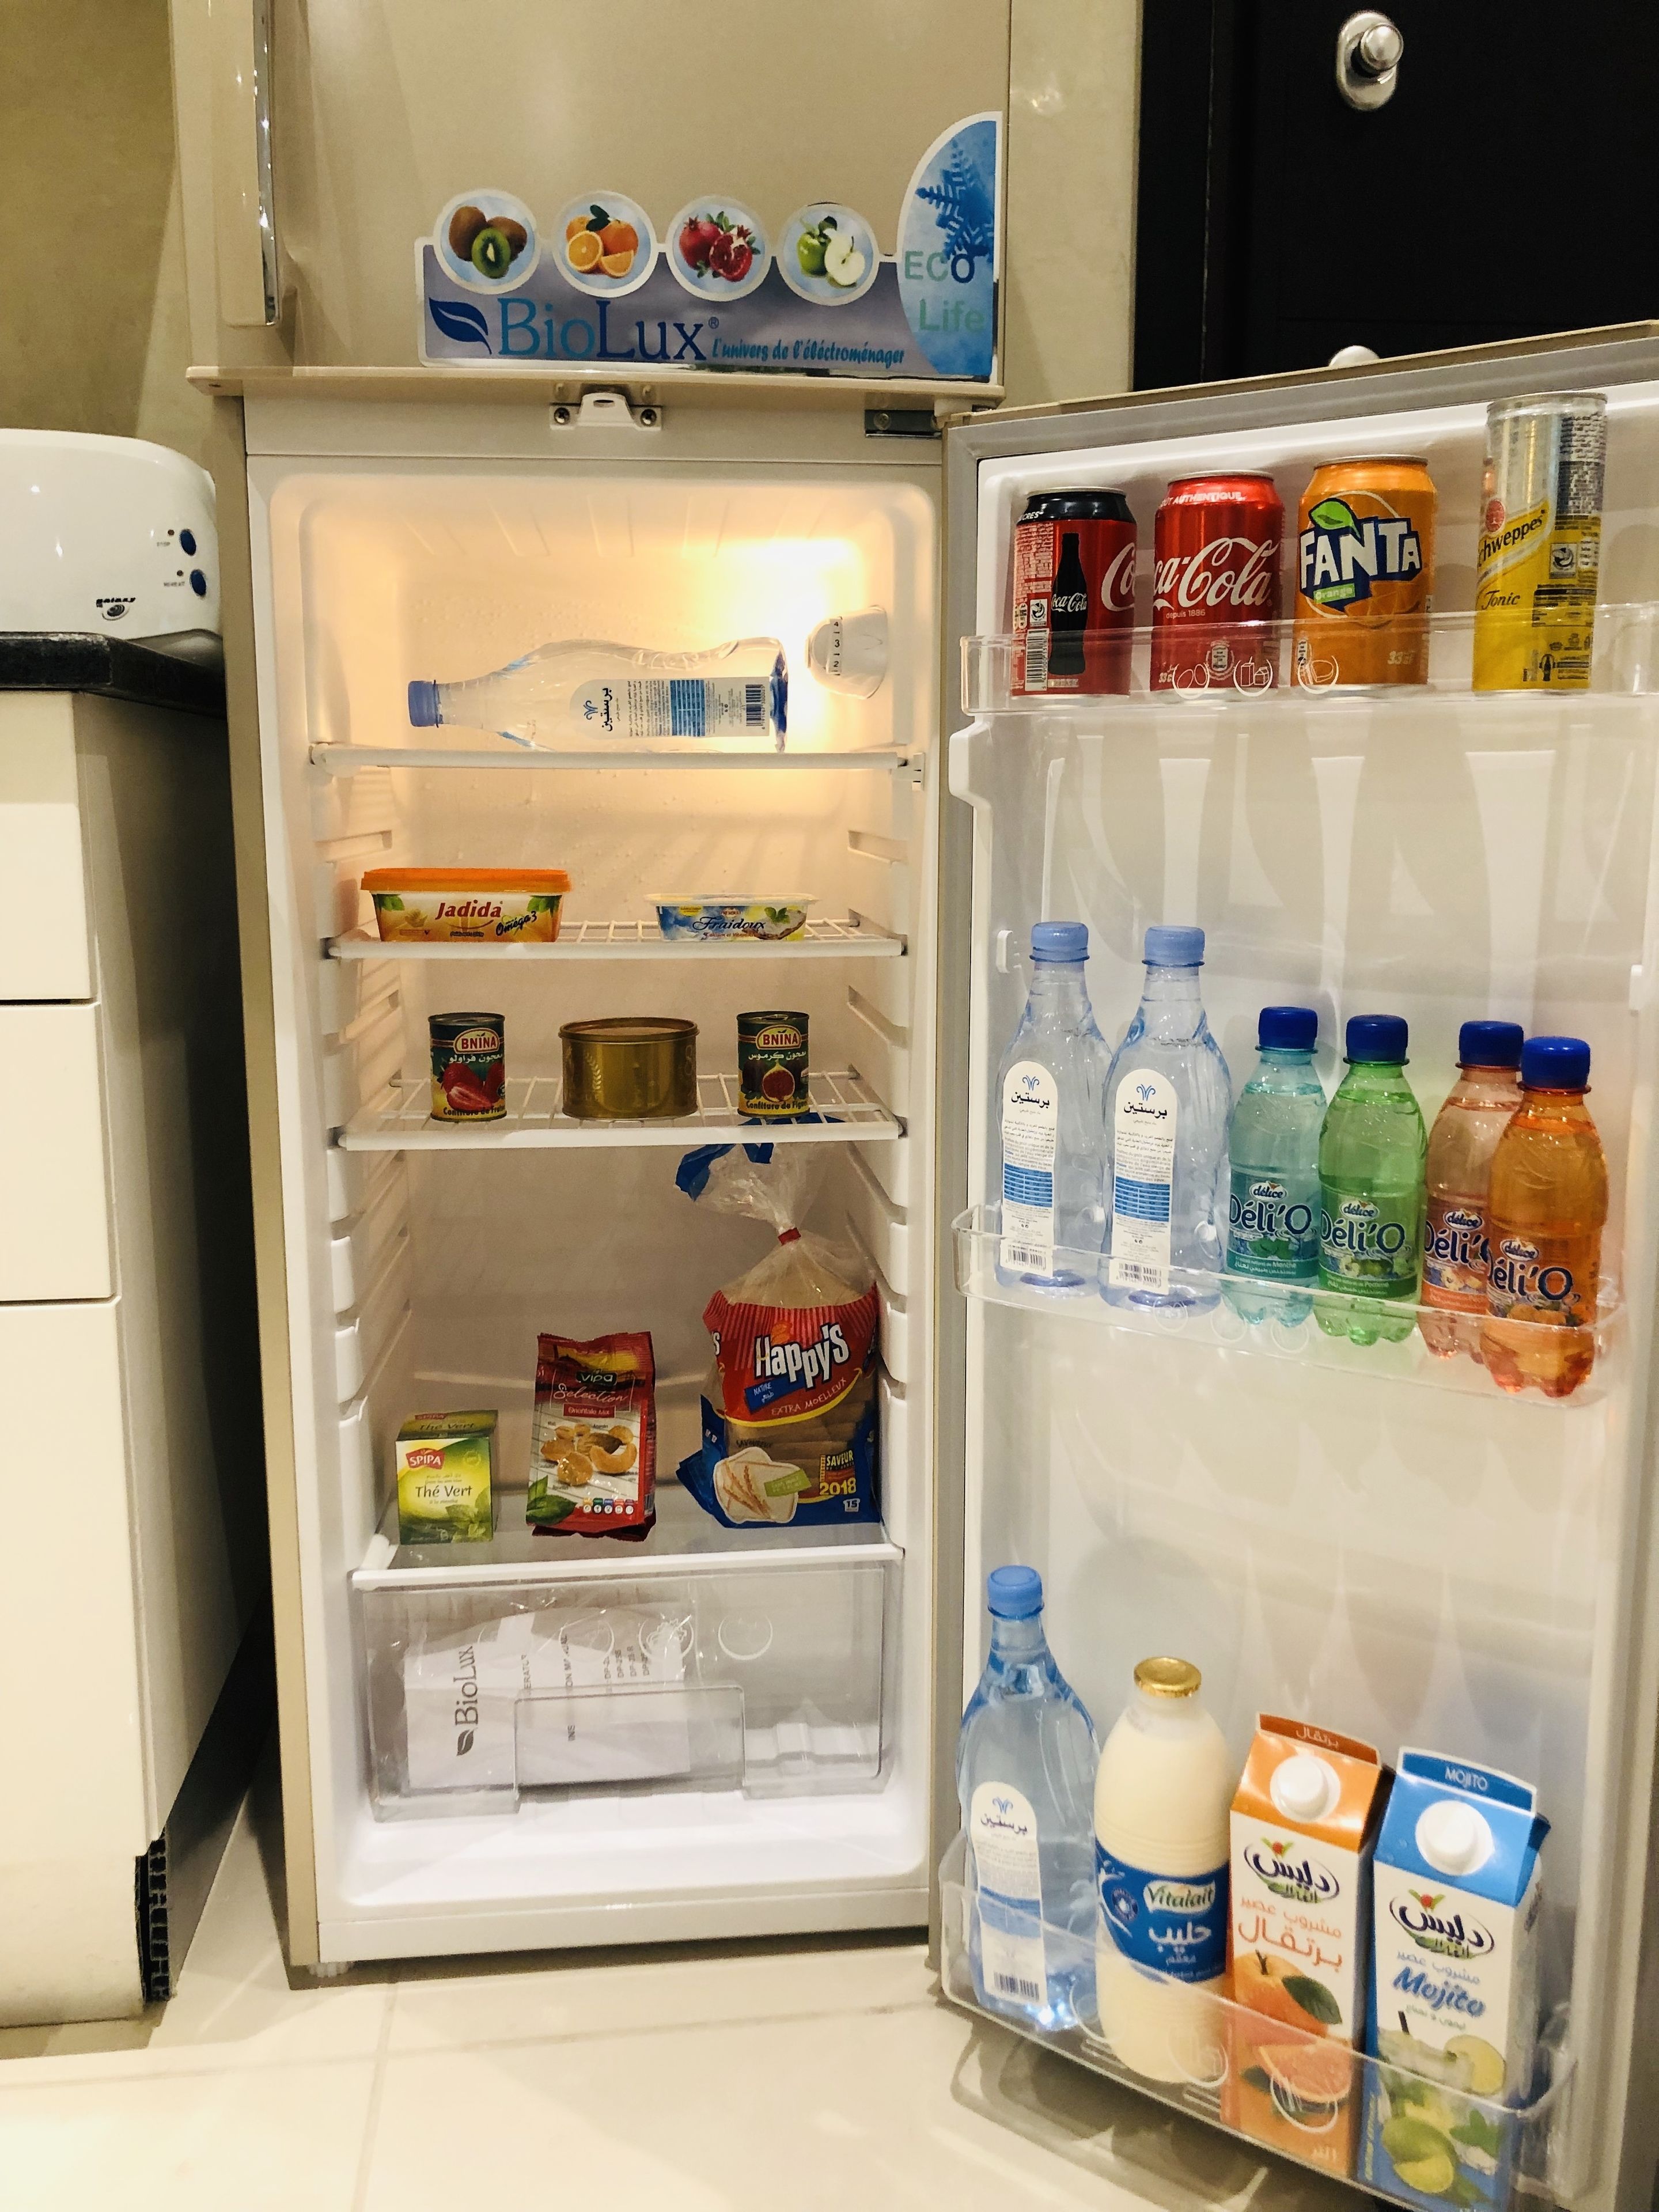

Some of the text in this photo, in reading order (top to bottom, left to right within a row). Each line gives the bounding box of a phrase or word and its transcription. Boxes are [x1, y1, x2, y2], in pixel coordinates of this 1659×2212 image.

[905, 251, 975, 283] ECO
[921, 300, 985, 333] Life
[713, 339, 768, 362] L'univers
[772, 340, 789, 360] de
[1478, 516, 1543, 566] chweppes
[1300, 521, 1421, 589] FANTA
[1051, 593, 1088, 612] Coca-Cola
[1482, 590, 1521, 609] Tonic
[1166, 609, 1206, 620] depuis 1886
[835, 639, 840, 647] 3
[601, 687, 613, 732] برستين
[435, 899, 502, 920] Jadida
[692, 916, 766, 931] Fraidoux
[461, 1036, 497, 1050] BNINA
[763, 1034, 798, 1046] BNINA
[746, 1101, 778, 1110] Confiture
[781, 1101, 791, 1109] de
[1011, 1091, 1050, 1108] برستين
[1123, 1100, 1168, 1119] برستين
[1253, 1185, 1284, 1199] délice
[1490, 1251, 1573, 1301] éli'O
[581, 1373, 613, 1383] vipa
[553, 1383, 628, 1403] Selection
[753, 1382, 772, 1396] NATURE
[771, 1377, 847, 1416] EXTRA MOELLEUX
[410, 1454, 441, 1467] SPIPA
[826, 1450, 854, 1467] SAVEUR
[415, 1485, 472, 1498] Thé Vert
[820, 1477, 857, 1495] 2018
[847, 1499, 858, 1508] 15
[453, 1645, 479, 1726] BioLux
[1296, 1726, 1339, 1749] برتقال
[1445, 1766, 1488, 1791] MOJITO
[980, 1813, 1028, 1835] برستين
[1147, 1884, 1213, 1908] Vitalait
[1238, 1914, 1343, 1973] برتقال
[1393, 1966, 1485, 2017] Mojito
